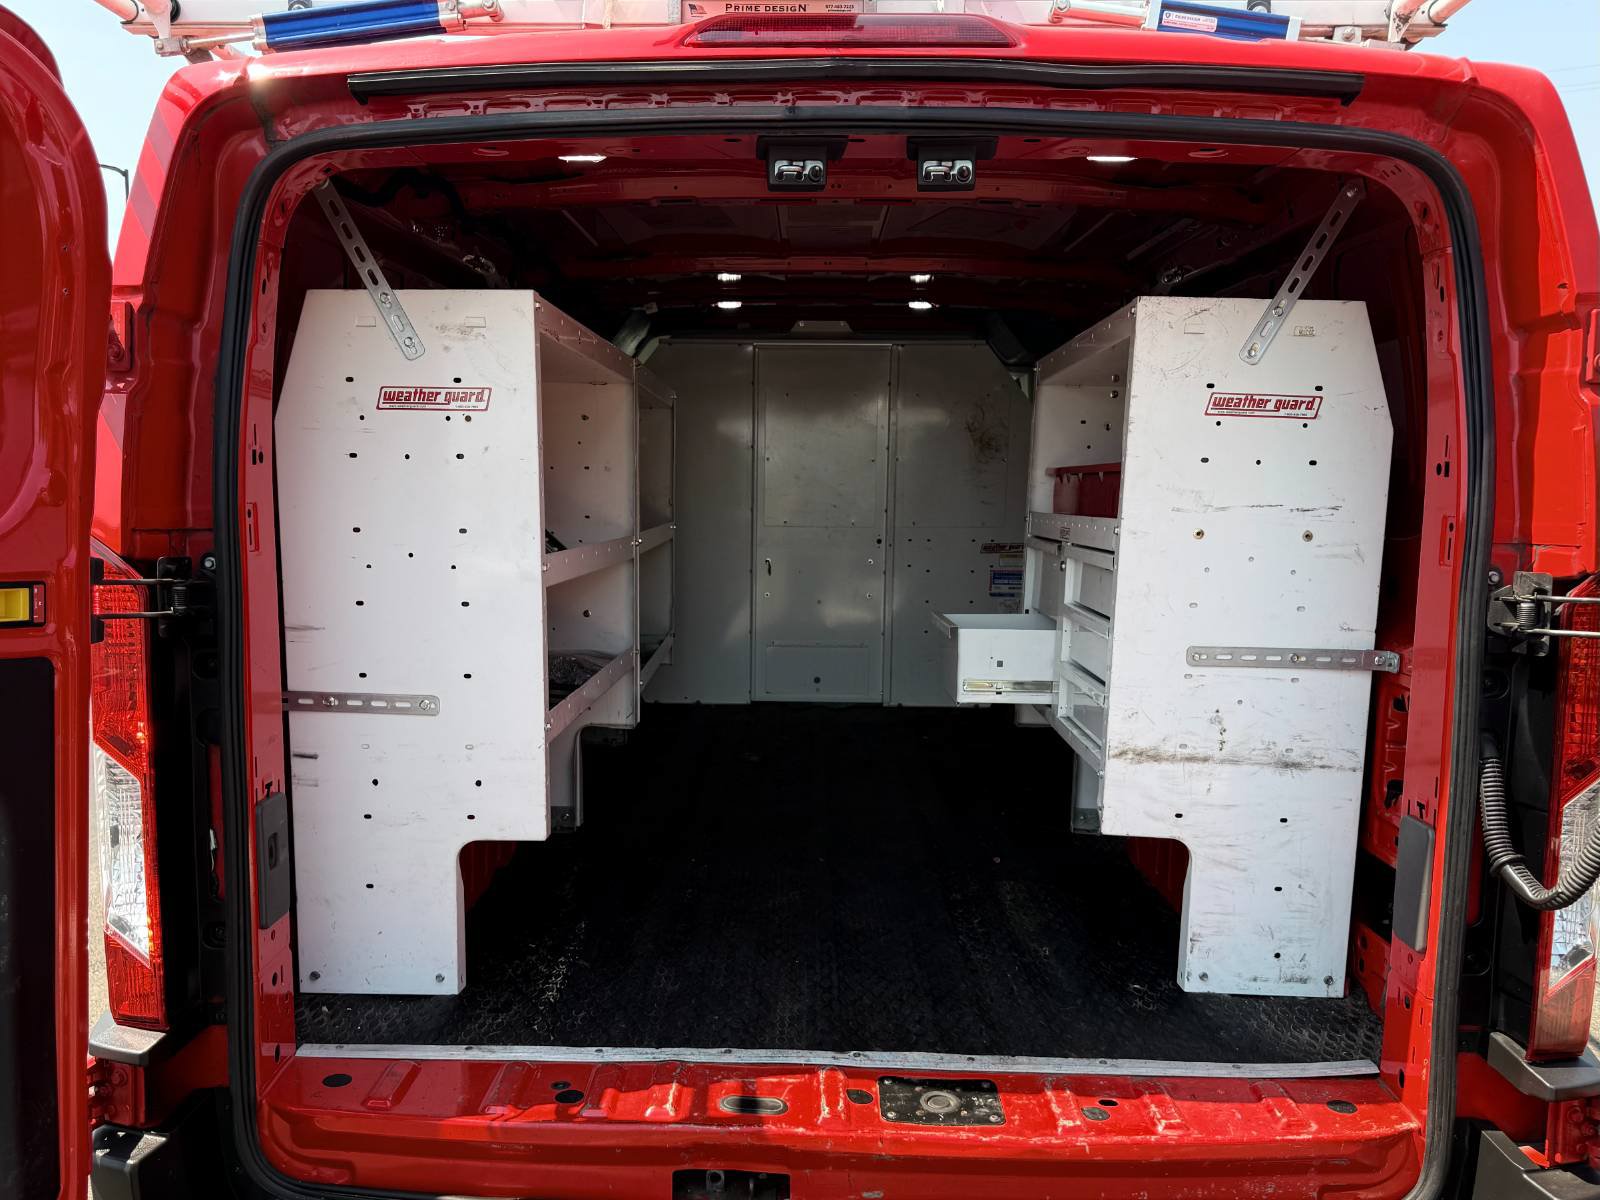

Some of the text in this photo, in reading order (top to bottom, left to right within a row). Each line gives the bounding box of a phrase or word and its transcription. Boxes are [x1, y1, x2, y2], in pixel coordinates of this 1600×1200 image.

[725, 3, 807, 12] PRIME DESIGN
[383, 388, 486, 405] weather guard
[1211, 395, 1316, 412] weather guard
